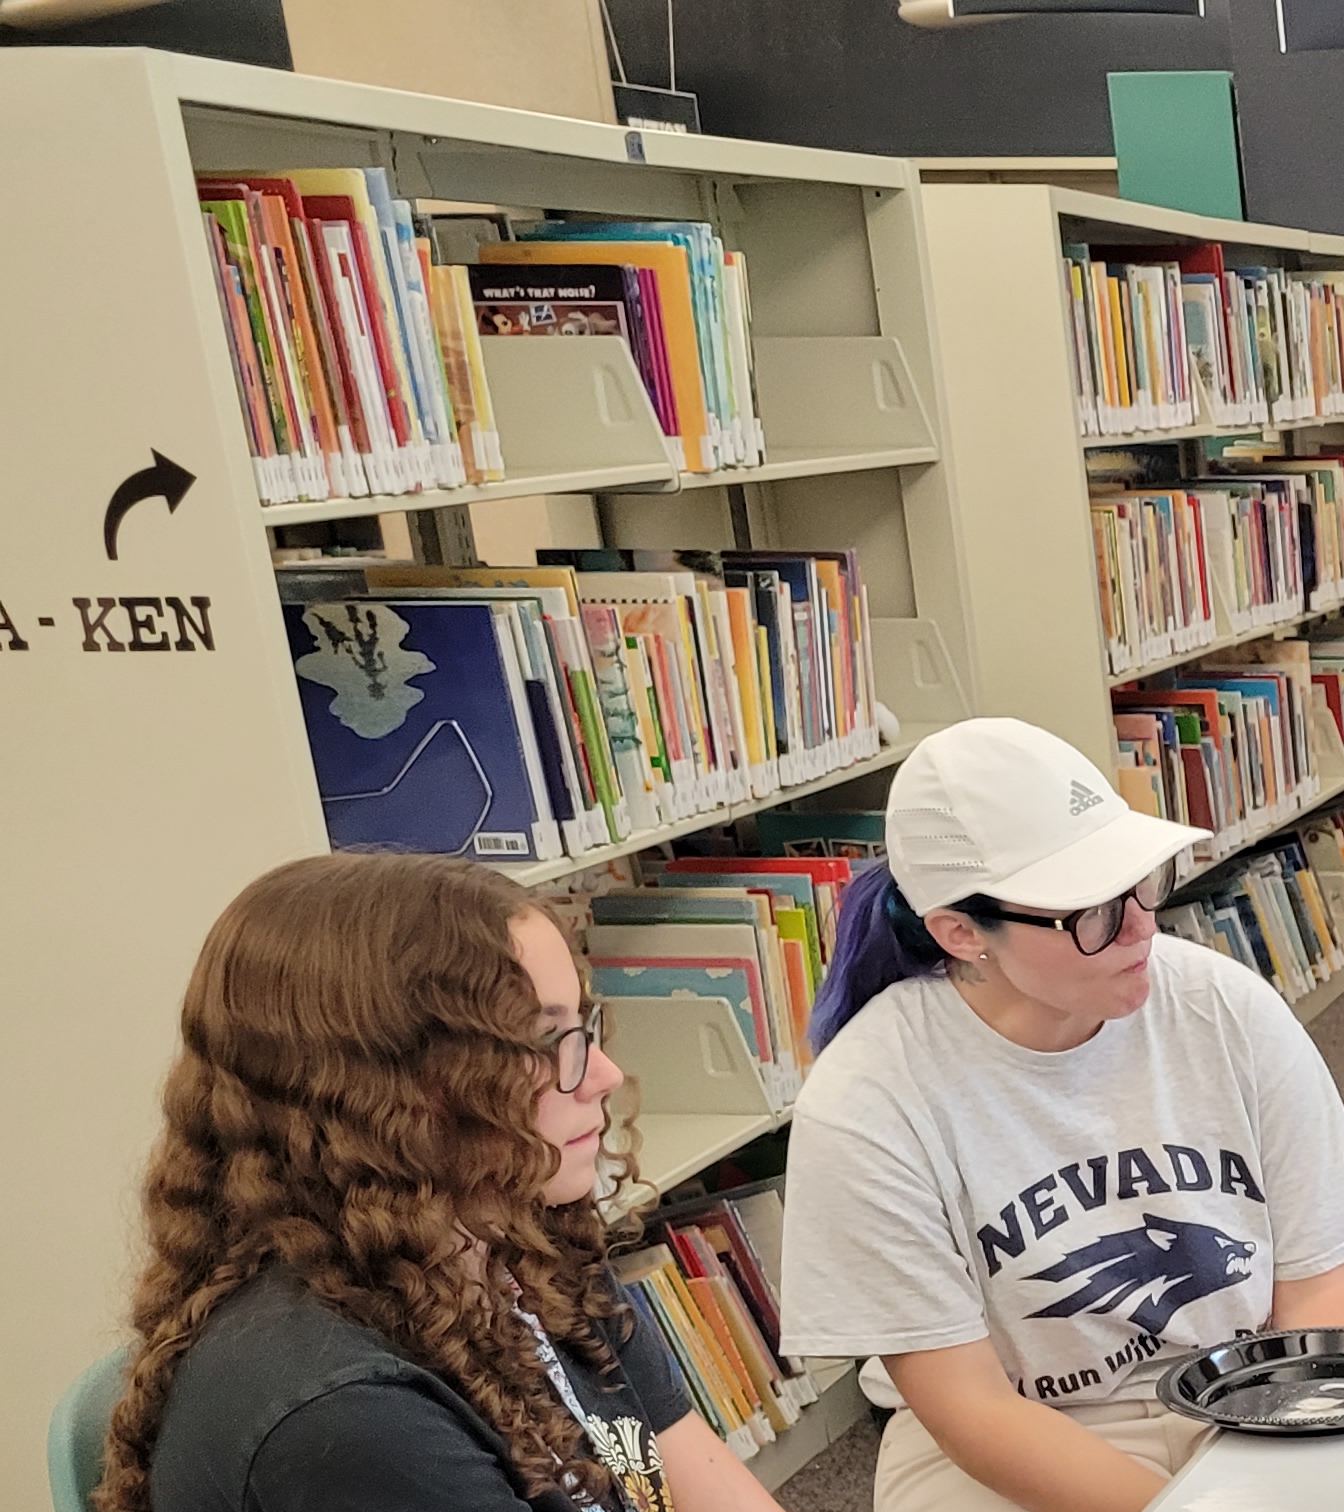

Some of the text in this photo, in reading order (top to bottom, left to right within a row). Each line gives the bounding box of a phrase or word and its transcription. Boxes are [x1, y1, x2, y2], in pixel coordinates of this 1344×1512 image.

[483, 284, 596, 298] WHAT'S THAT NOISE?
[72, 596, 216, 652] KEN
[976, 1143, 1266, 1278] NEVADA
[1034, 1368, 1102, 1399] Run
